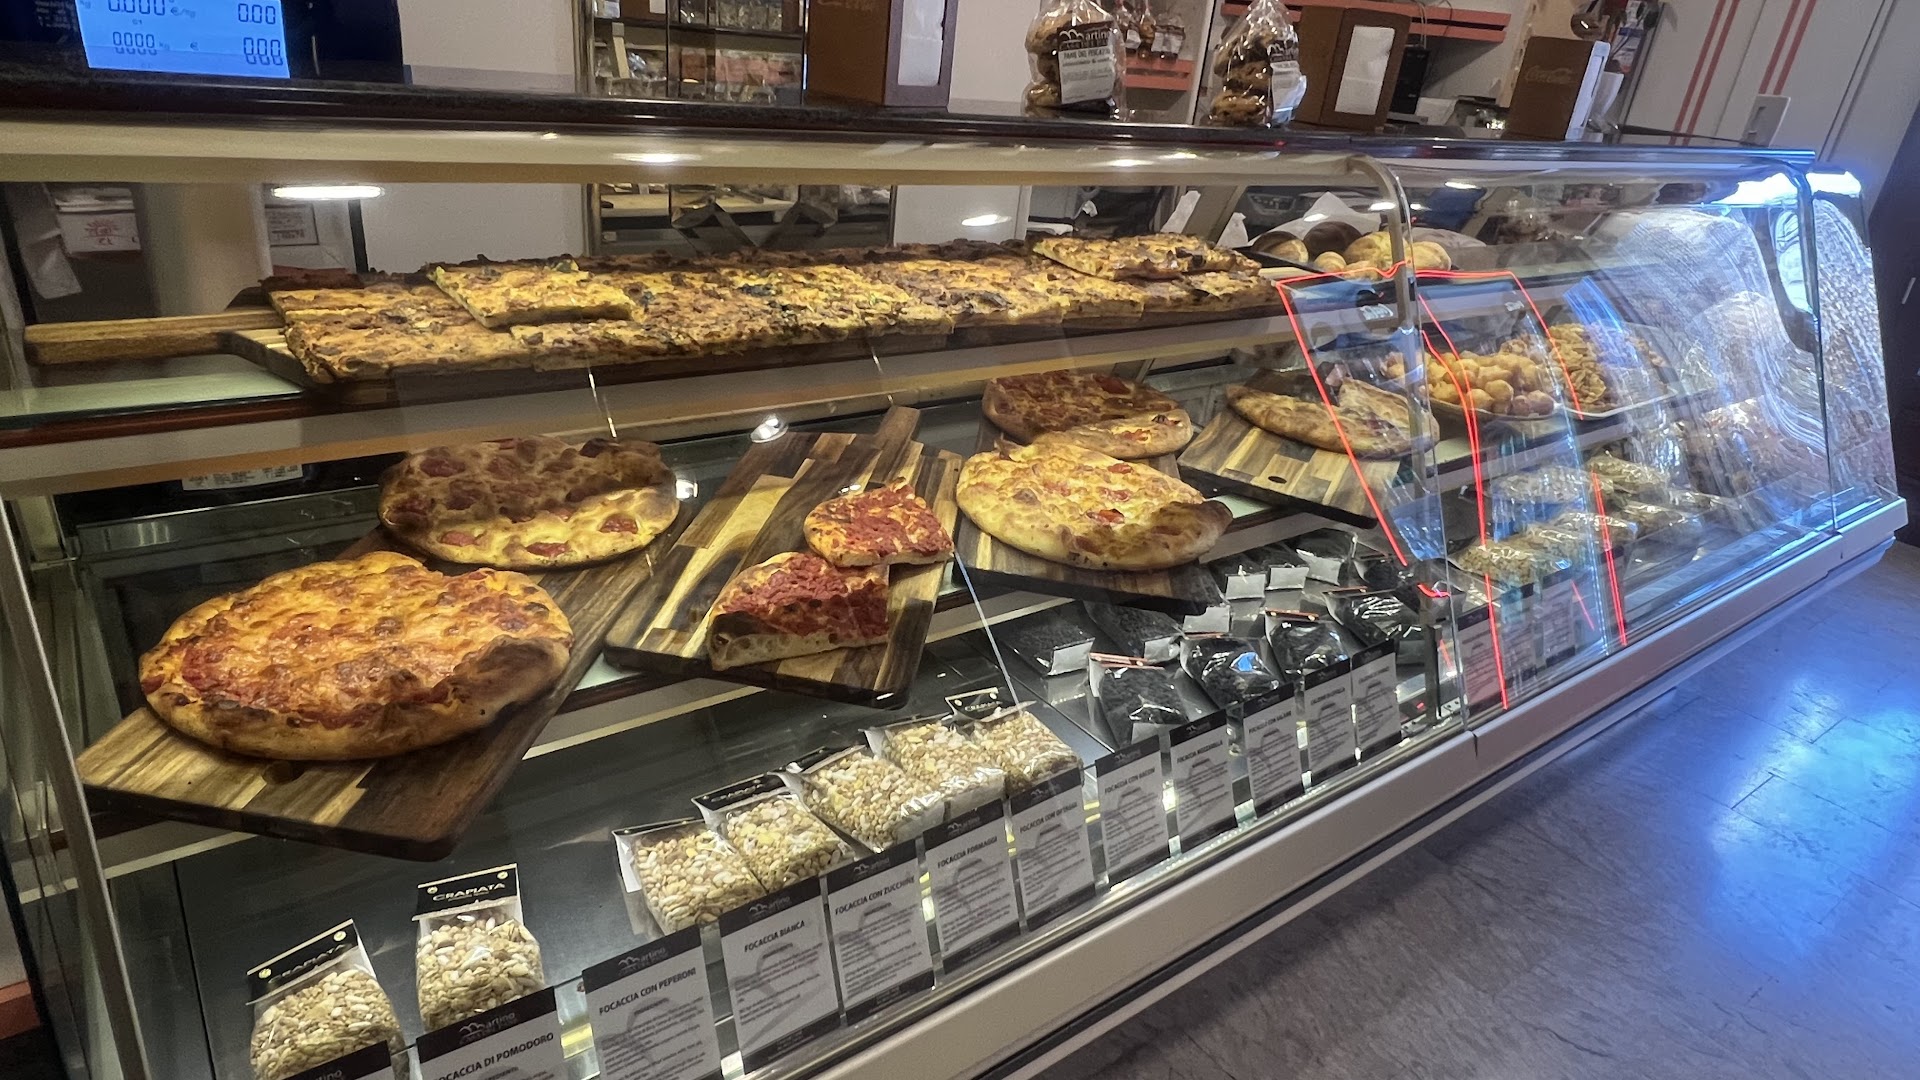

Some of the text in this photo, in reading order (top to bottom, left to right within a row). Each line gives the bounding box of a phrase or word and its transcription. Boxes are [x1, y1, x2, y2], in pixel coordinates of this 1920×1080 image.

[432, 883, 506, 901] CRAPIATA
[834, 896, 868, 916] FOCACCIA
[868, 890, 883, 901] CON
[744, 920, 805, 953] FOCACCIA BIANCA
[599, 967, 697, 1016] FOCACCIA CON PEPERONI
[484, 1056, 495, 1067] DI
[496, 1032, 554, 1063] POMODORO
